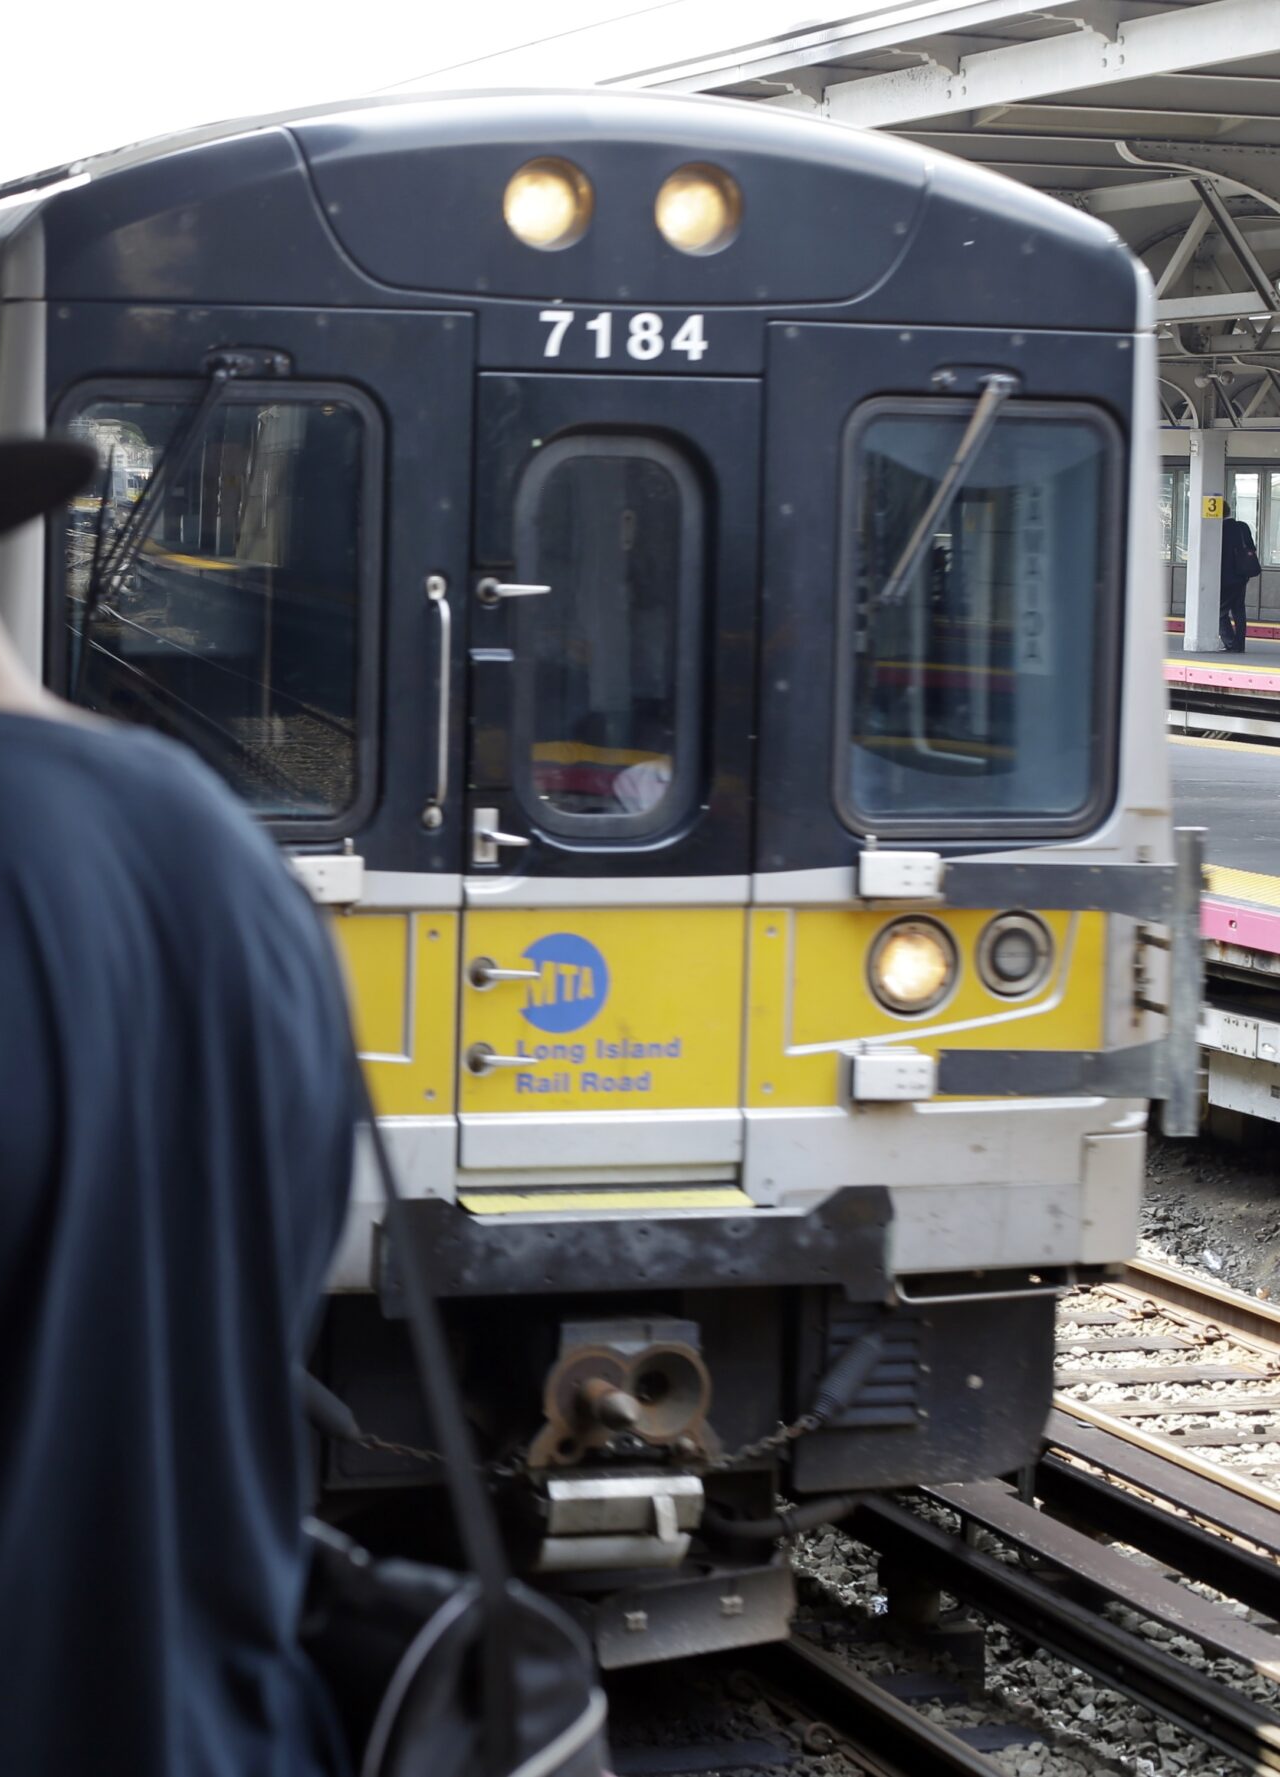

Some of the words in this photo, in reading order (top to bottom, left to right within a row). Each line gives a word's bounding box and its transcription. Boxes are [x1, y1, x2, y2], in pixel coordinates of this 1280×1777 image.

[539, 310, 708, 361] 7184
[1207, 497, 1217, 512] 3
[520, 958, 595, 1010] MTA
[516, 1039, 586, 1064] Long
[596, 1036, 682, 1059] Island
[515, 1071, 570, 1094] Rail
[581, 1070, 652, 1093] Road
